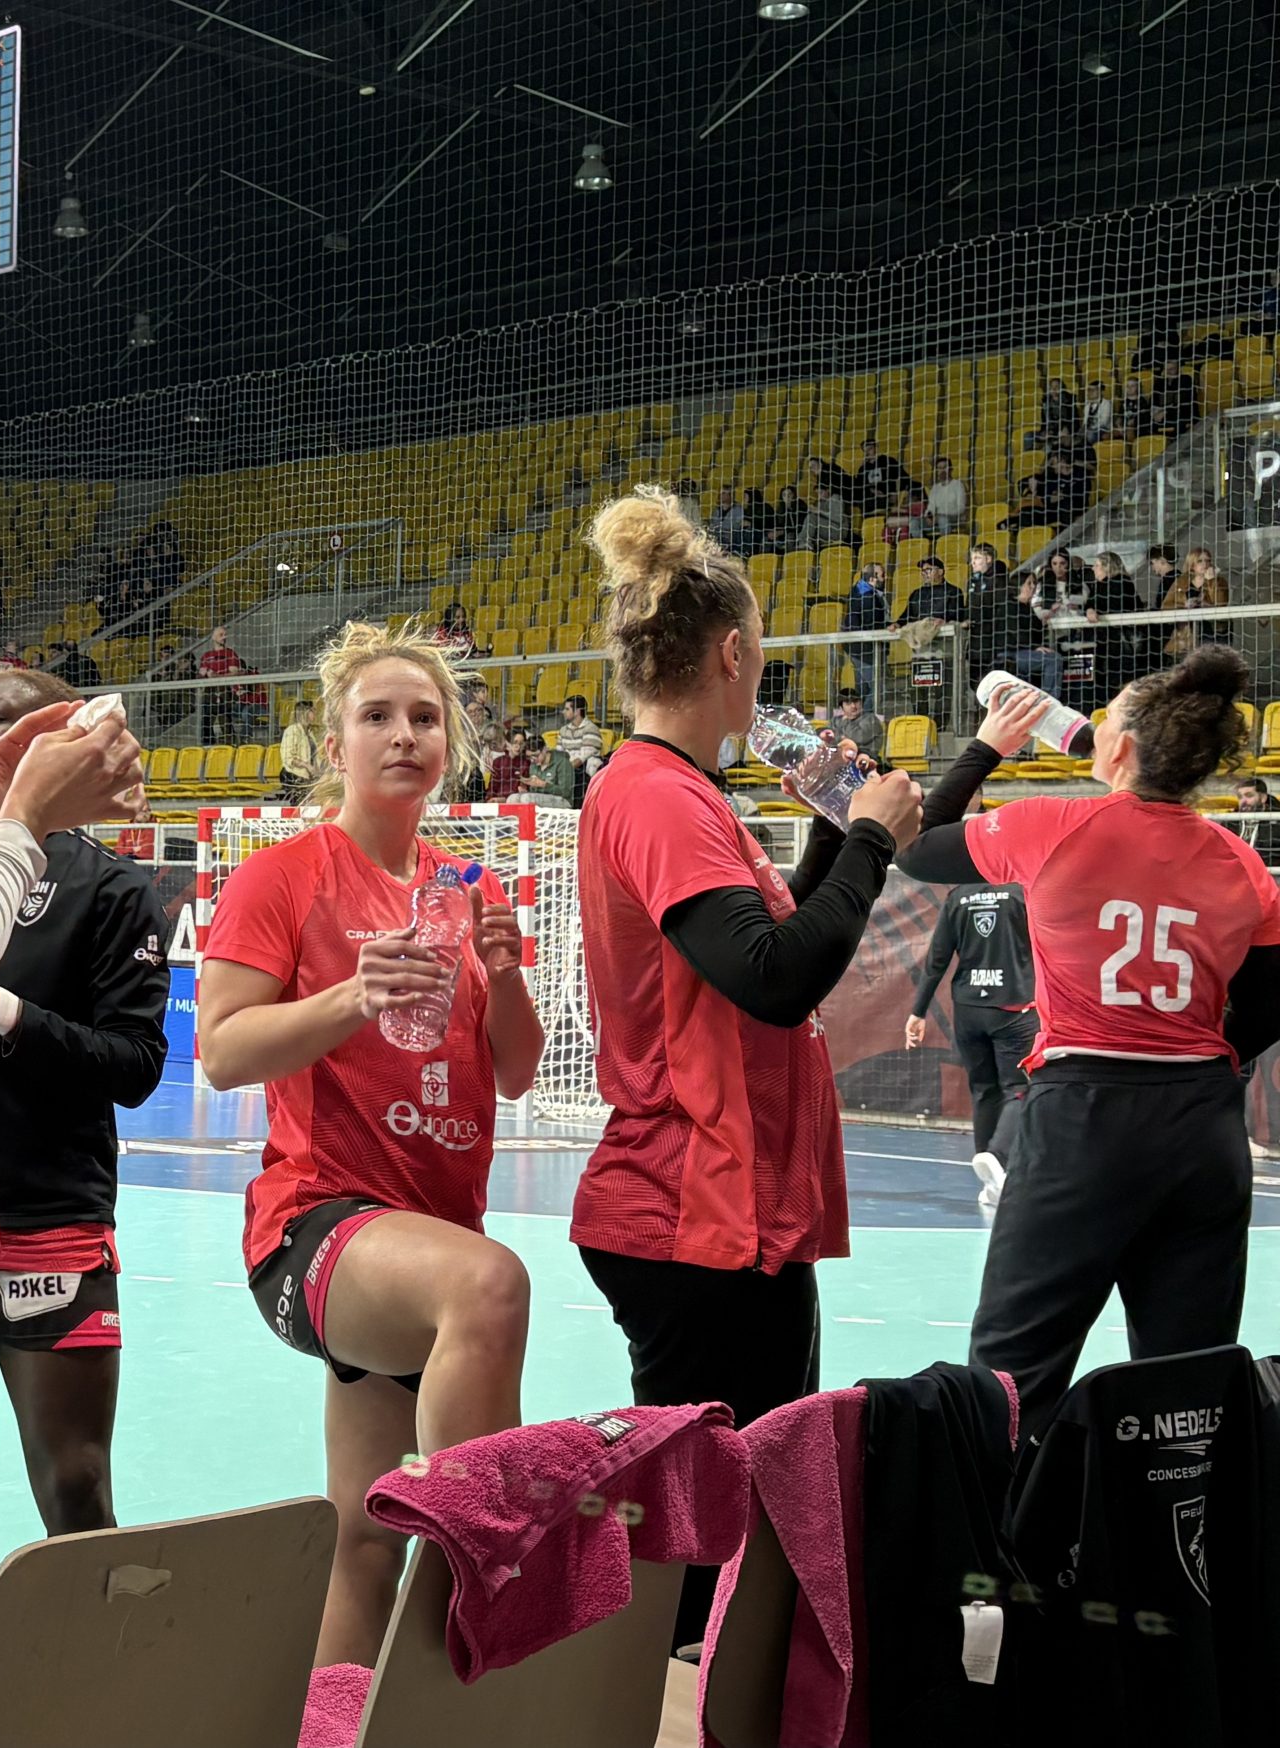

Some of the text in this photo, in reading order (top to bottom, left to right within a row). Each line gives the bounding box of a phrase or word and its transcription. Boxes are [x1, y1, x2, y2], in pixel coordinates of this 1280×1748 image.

[346, 930, 387, 940] CRAF
[1098, 899, 1199, 1013] 25
[306, 1227, 338, 1287] BREST
[9, 1275, 66, 1299] ASKEL
